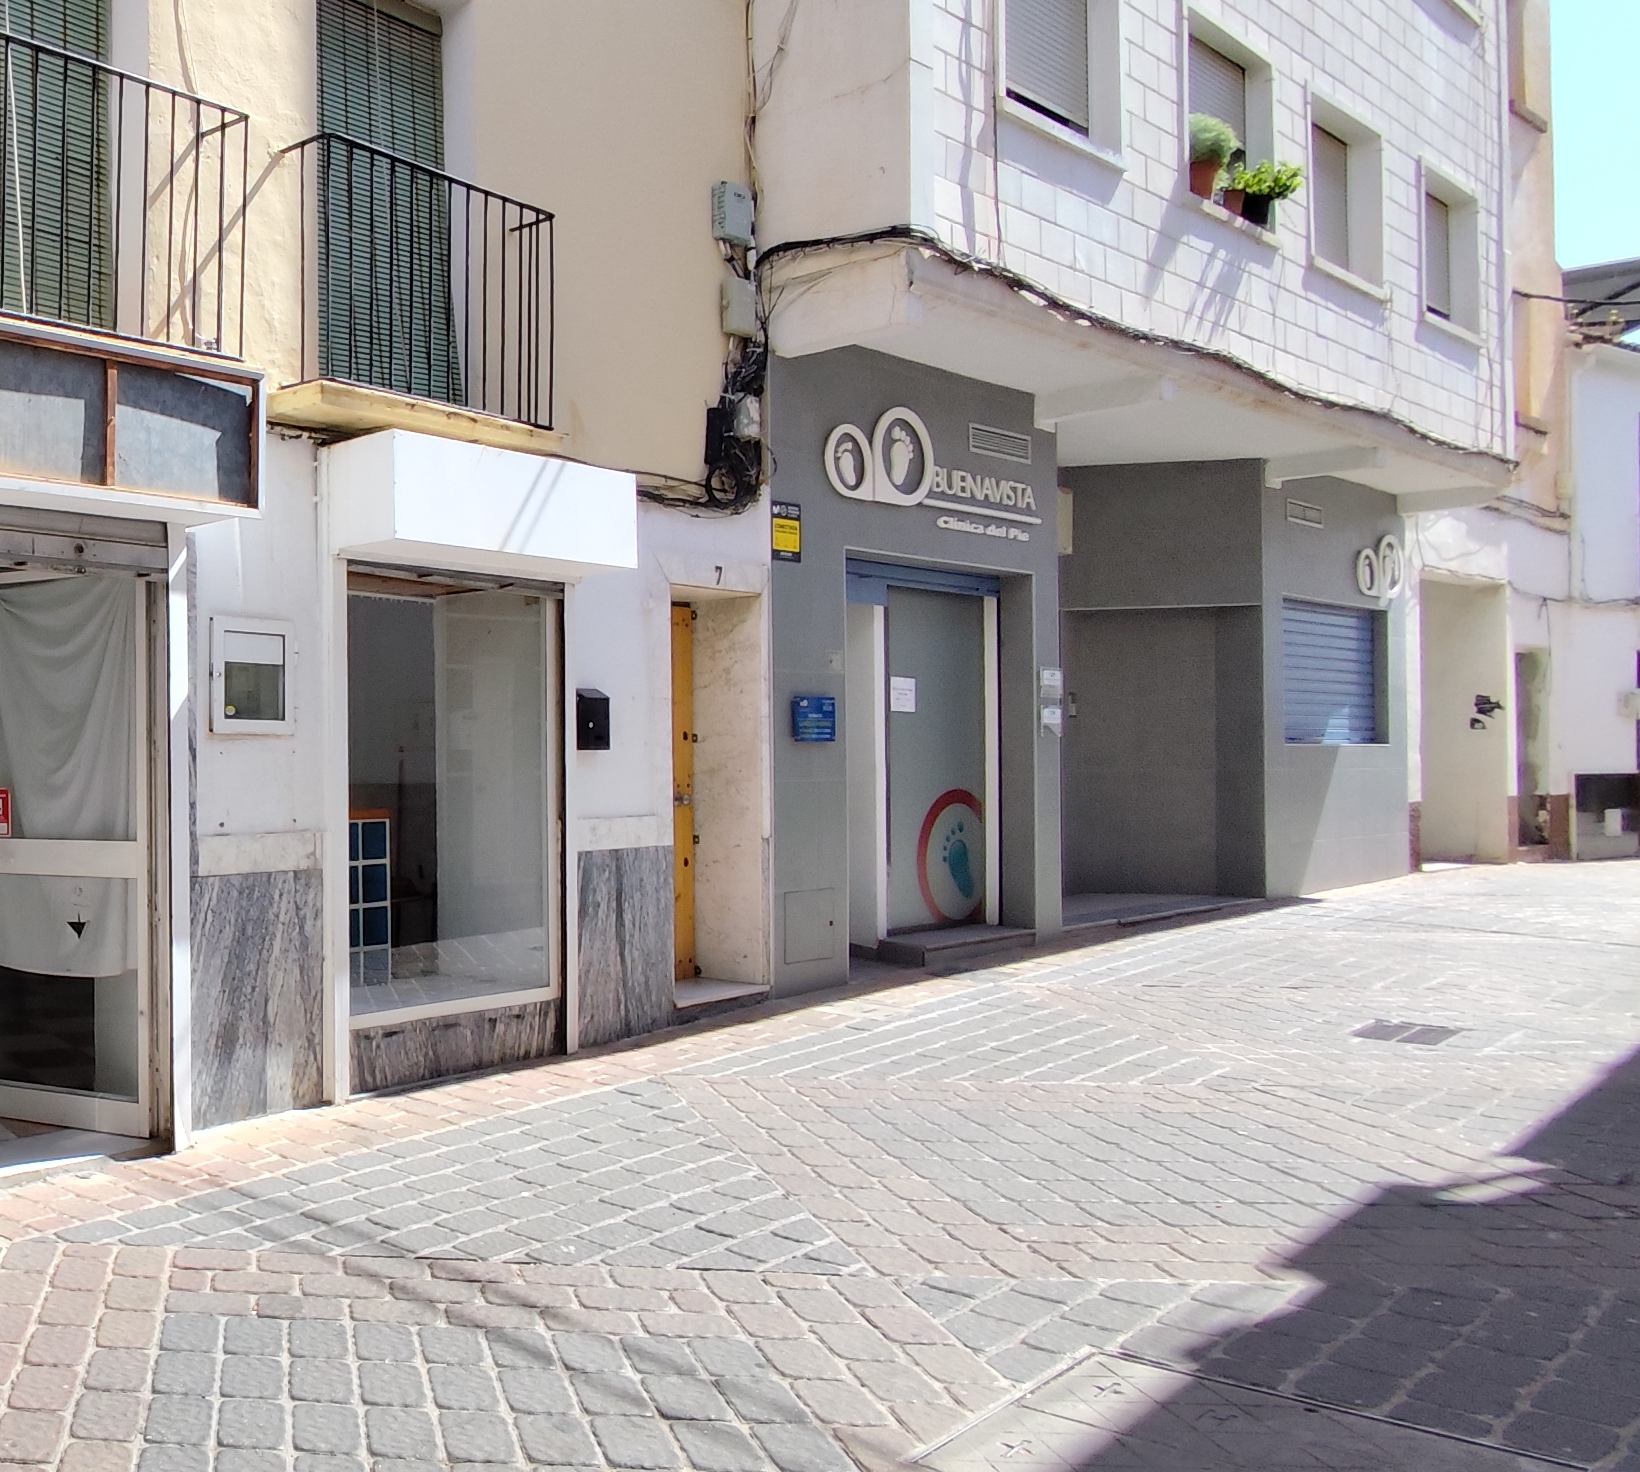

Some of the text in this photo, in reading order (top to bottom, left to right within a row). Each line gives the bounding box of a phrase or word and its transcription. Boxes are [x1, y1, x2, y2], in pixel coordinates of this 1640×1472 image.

[932, 466, 1037, 511] BUENAVISTA
[985, 524, 1007, 538] del
[1007, 527, 1030, 542] Pie
[715, 565, 723, 586] 7
